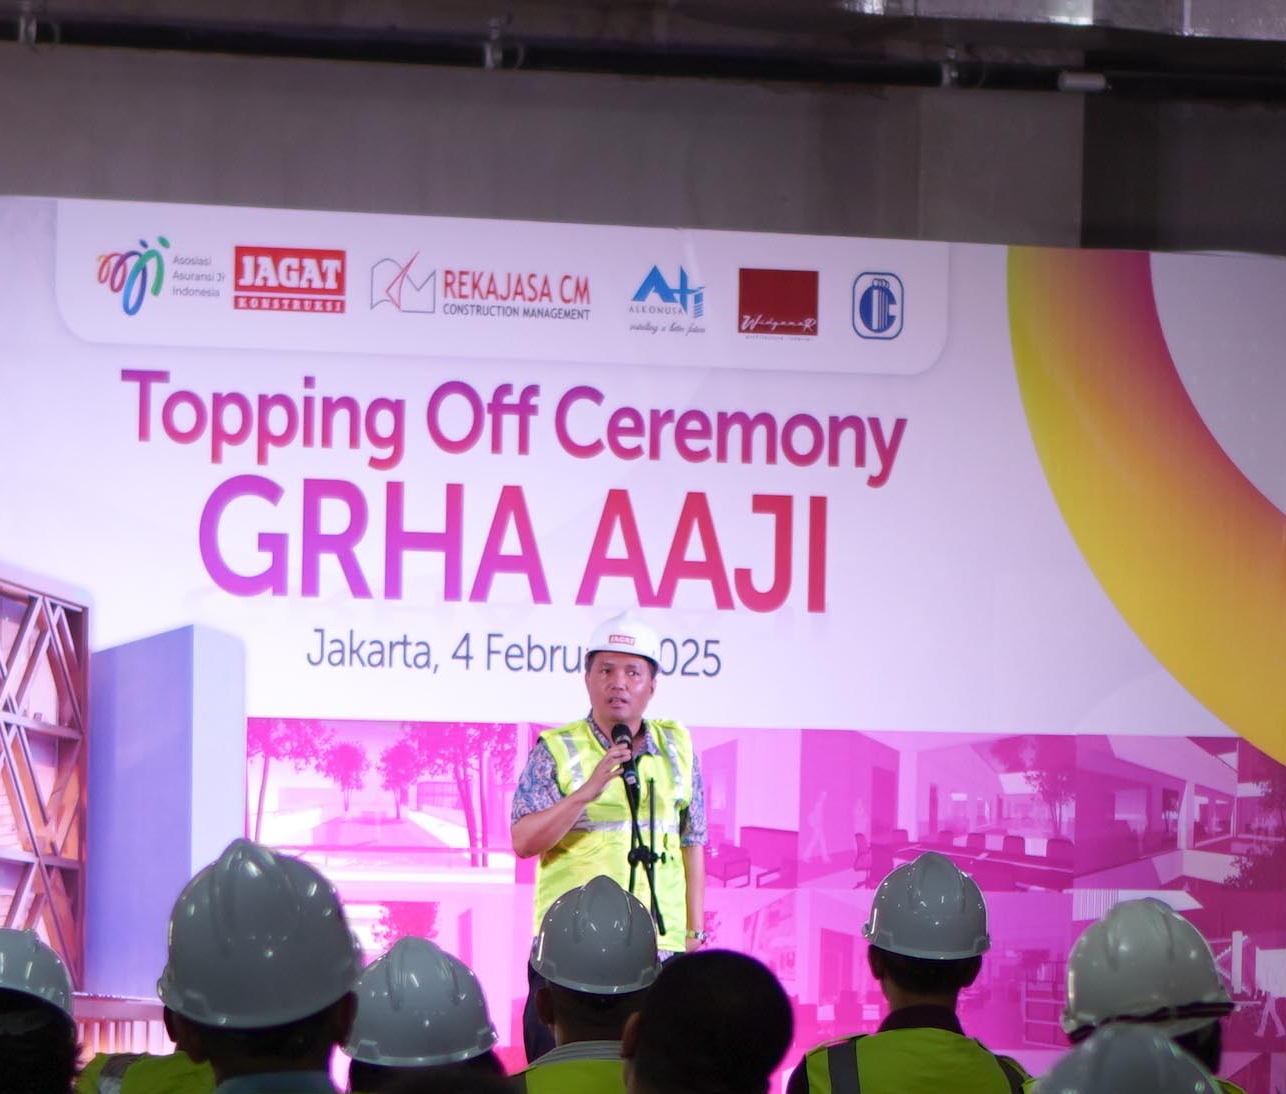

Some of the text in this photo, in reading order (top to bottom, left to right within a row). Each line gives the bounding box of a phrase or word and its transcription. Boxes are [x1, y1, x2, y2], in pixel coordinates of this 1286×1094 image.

[172, 255, 212, 266] Asosiasi
[172, 269, 215, 281] Asuransi
[239, 255, 342, 289] JAGAT
[172, 286, 220, 298] Indonesia
[443, 270, 591, 304] REKAJASA CM
[238, 297, 342, 312] KONSTRUKSI
[443, 303, 591, 320] CONSTRUCTION MANAGEMENT
[628, 305, 684, 316] ALKONUSA
[120, 368, 907, 490] Topping Off Ceremony
[198, 474, 827, 613] GRHA AAJI
[306, 628, 722, 678] Jakarta, 4 Febru 025
